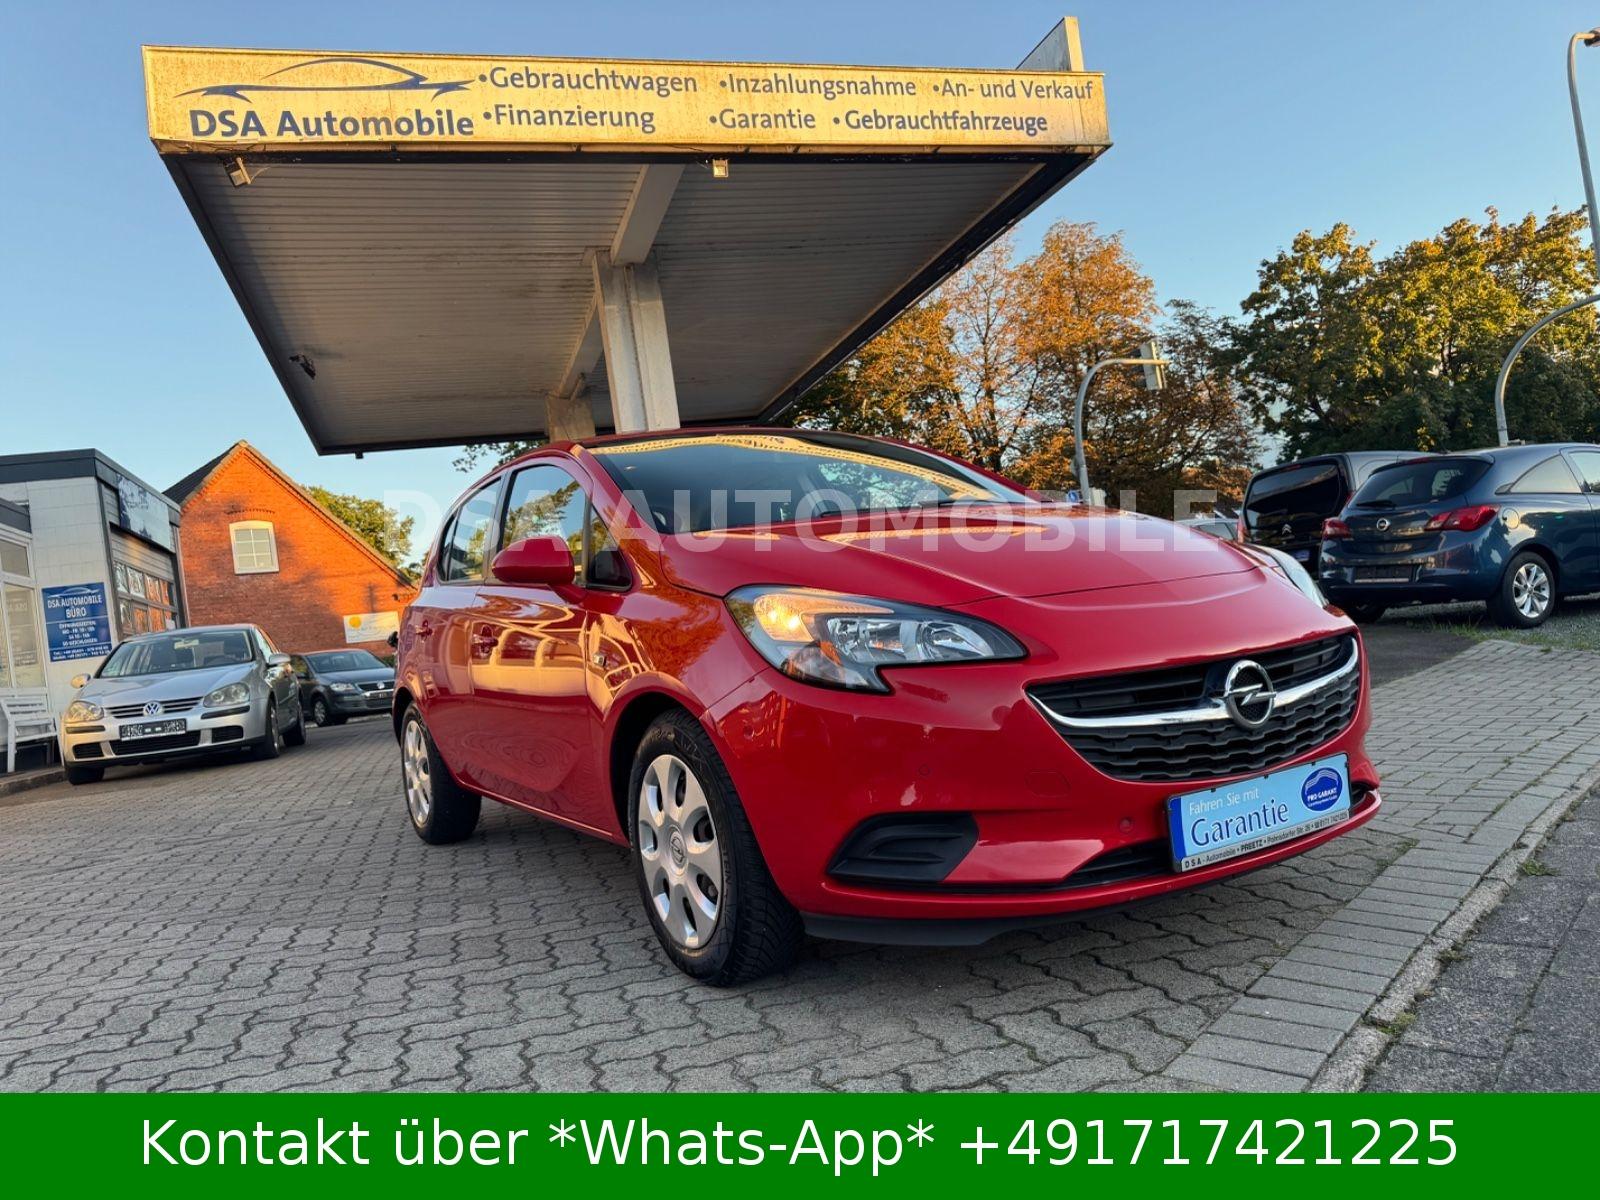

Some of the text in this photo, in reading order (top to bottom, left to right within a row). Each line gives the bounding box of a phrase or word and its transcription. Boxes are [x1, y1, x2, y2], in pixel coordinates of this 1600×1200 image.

[489, 66, 698, 98] Gebrauchtwagen
[728, 72, 917, 100] Inzahlungsnahme
[940, 77, 1094, 100] An- und Verkauf
[188, 108, 475, 137] DSA Automobile
[494, 104, 656, 134] Finanzierung
[719, 108, 816, 130] Garantie
[846, 110, 1049, 136] Gebrauchtfahrzeuge
[61, 594, 103, 607] AUTOMOBILE
[65, 606, 87, 618] BÜRO
[1188, 787, 1260, 816] Fahren Sie mit
[1191, 799, 1289, 846] Garantie
[1240, 839, 1264, 852] PREETZ
